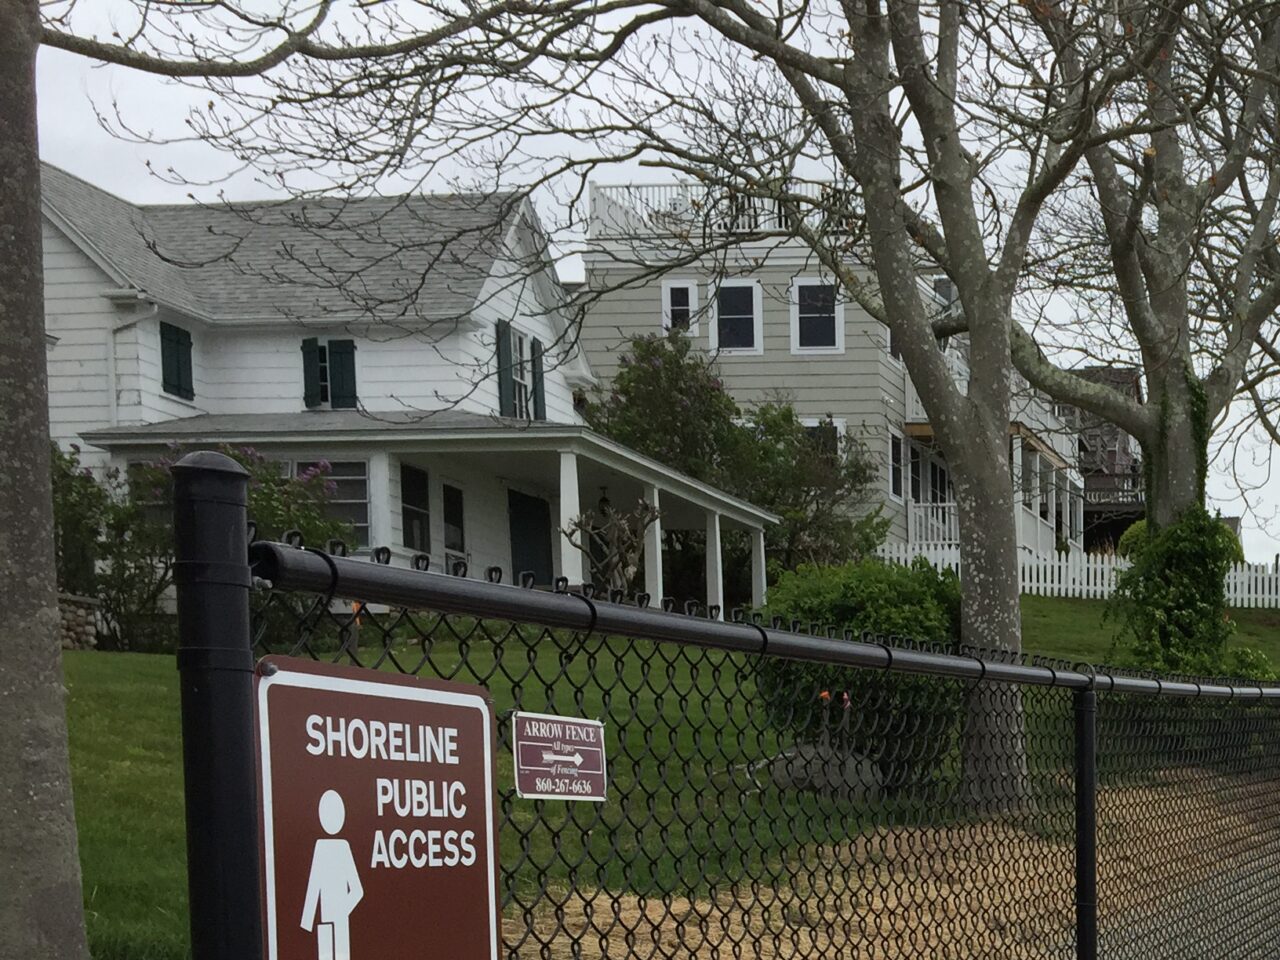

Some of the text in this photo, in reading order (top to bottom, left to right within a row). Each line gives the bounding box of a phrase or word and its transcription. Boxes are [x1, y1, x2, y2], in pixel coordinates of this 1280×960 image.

[305, 714, 459, 765] SHORELINE
[523, 721, 597, 742] ARROW FENCE
[552, 741, 560, 751] All
[376, 778, 467, 819] PUBLIC
[535, 777, 592, 794] 860-267-6636
[370, 829, 476, 869] ACCESS
